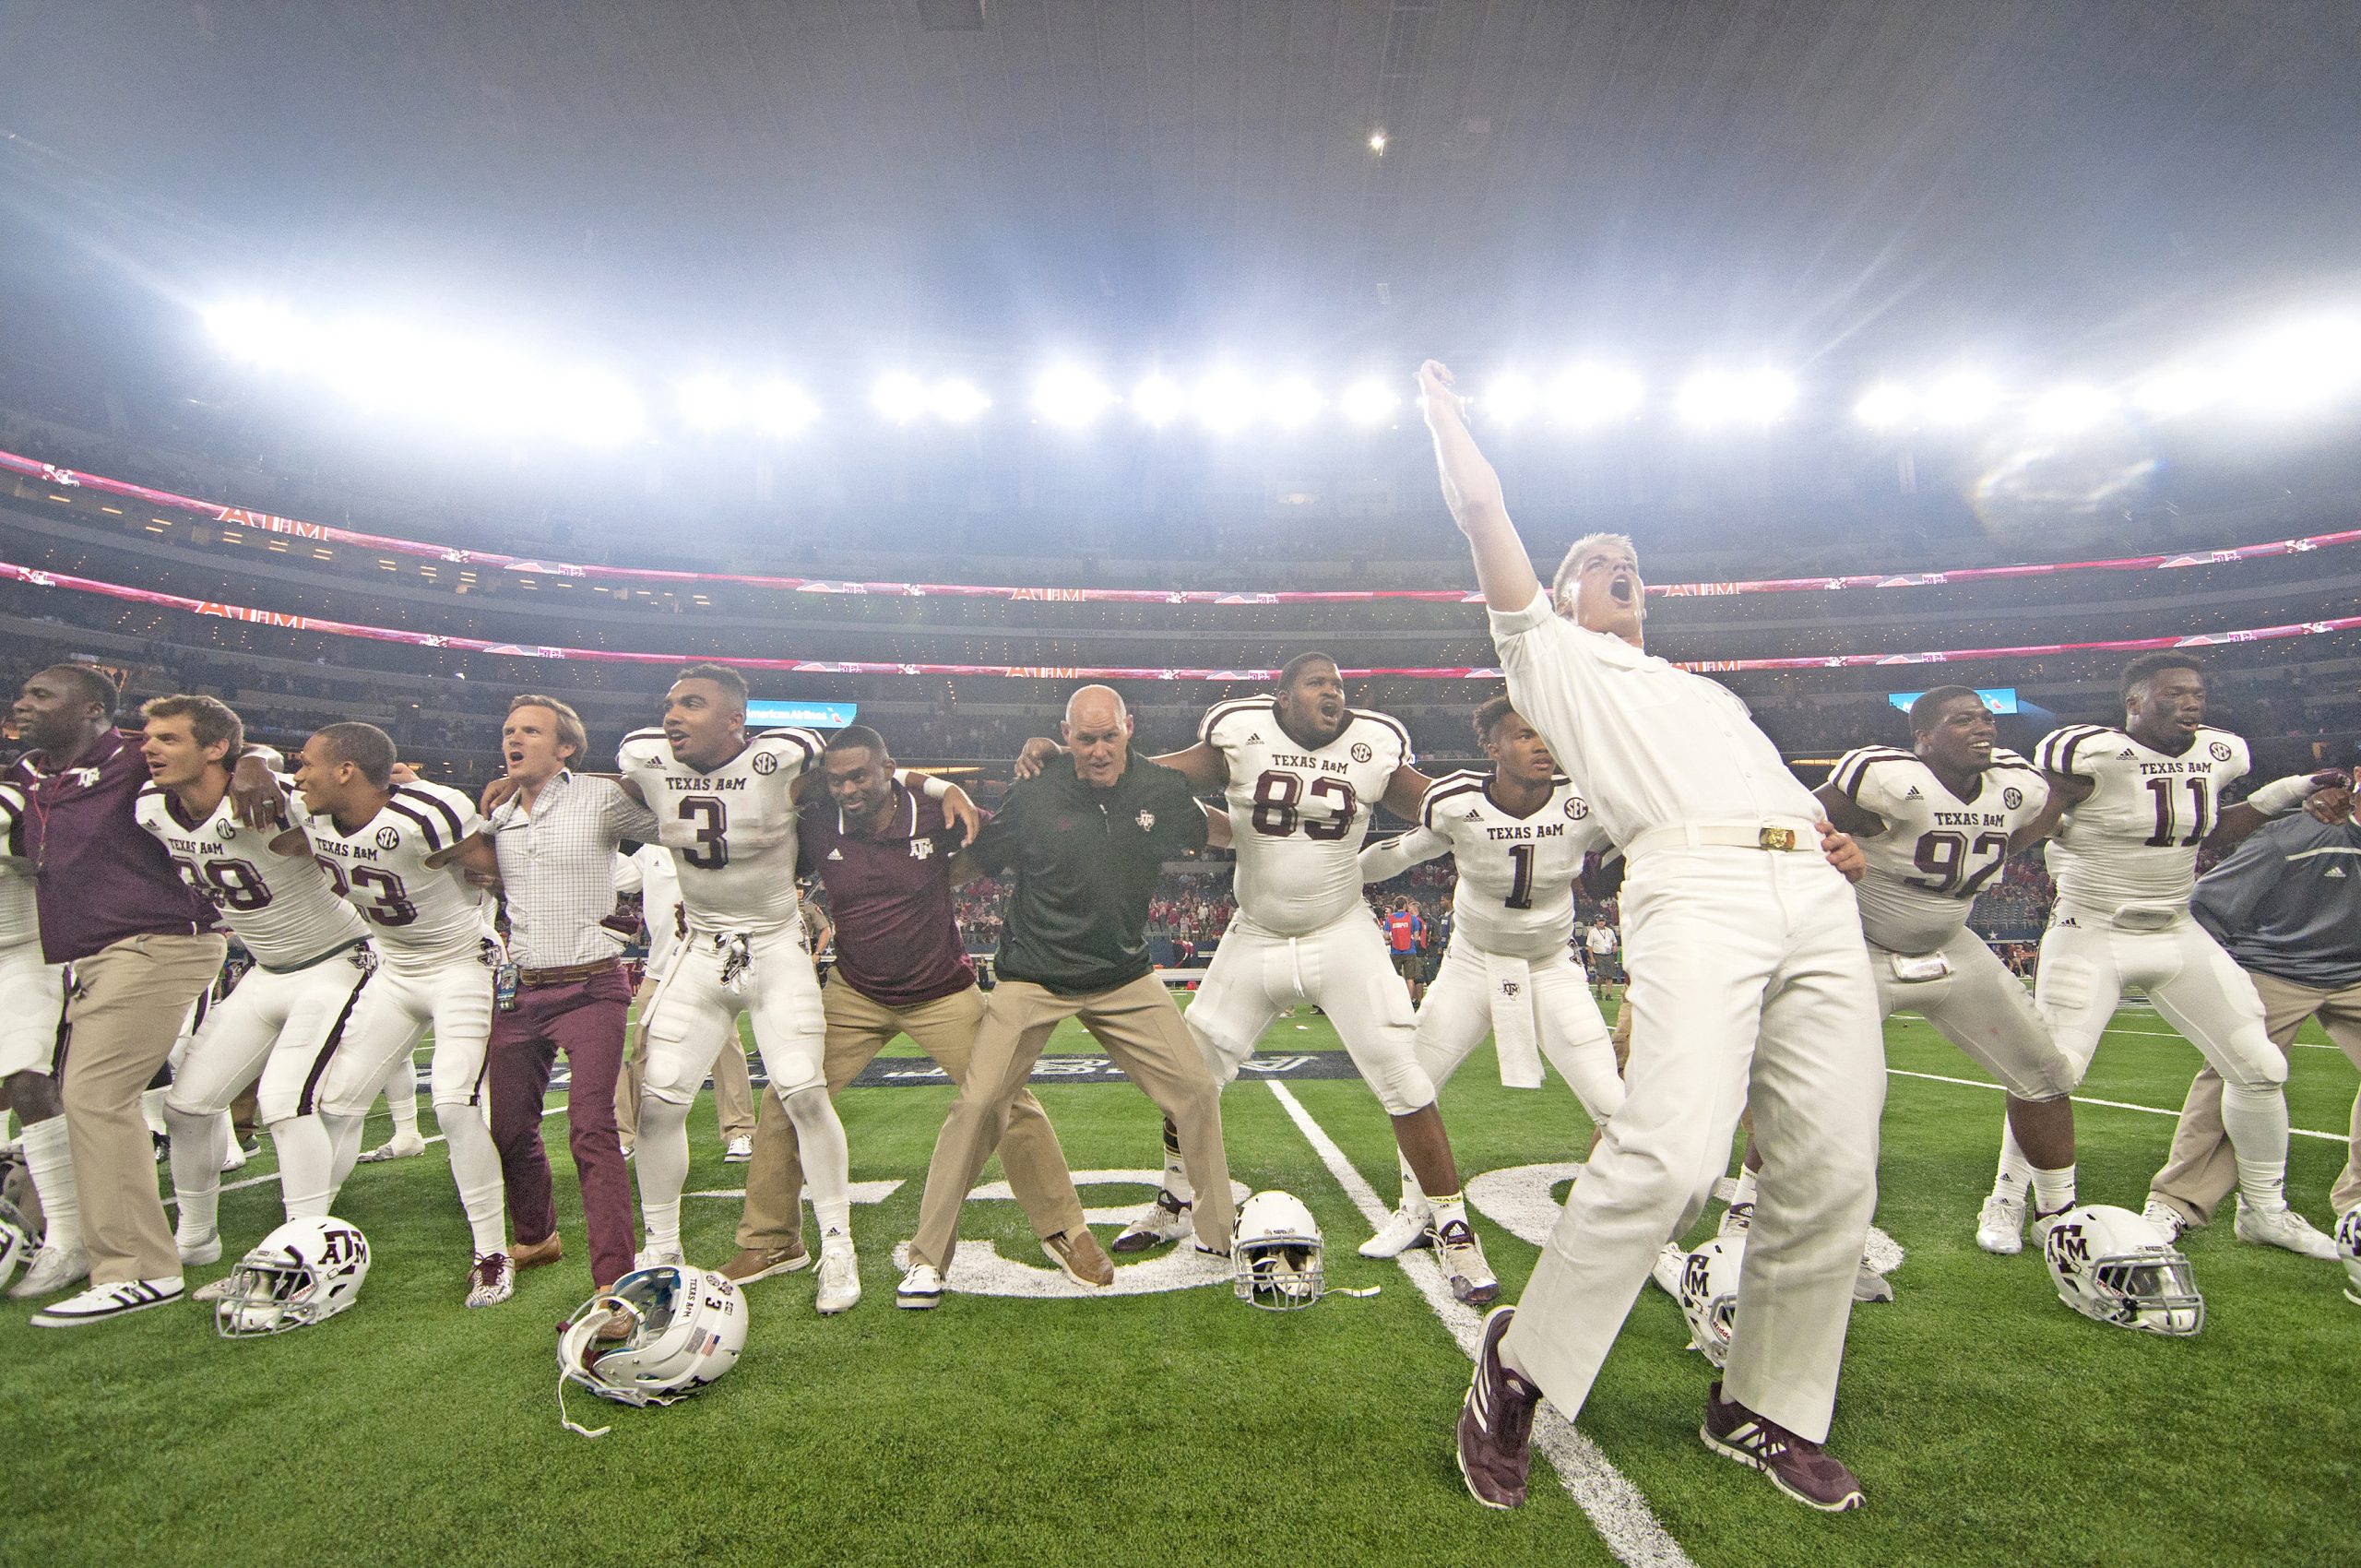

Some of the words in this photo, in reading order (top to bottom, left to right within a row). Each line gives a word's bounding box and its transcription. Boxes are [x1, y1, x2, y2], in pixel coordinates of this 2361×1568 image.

[753, 753, 777, 774] SEC
[1352, 743, 1372, 763] SEC
[1272, 754, 1317, 769] TEXAS
[1321, 760, 1349, 775] A&M
[2140, 763, 2185, 776] TEXAS
[2189, 763, 2213, 774] A&M
[665, 778, 710, 791] TEXAS
[715, 778, 747, 790] A&M
[1252, 769, 1357, 840] 83
[1565, 798, 1587, 820] SEC
[2004, 789, 2022, 809] SEC
[1934, 813, 1979, 826] TEXAS
[1983, 814, 2005, 827] A&M
[2143, 777, 2209, 848] 11
[377, 828, 399, 848] SEC
[678, 795, 729, 869] 3
[1487, 826, 1531, 840] TEXAS
[1536, 823, 1564, 838] A&M
[167, 837, 196, 854] TEXAS
[200, 841, 224, 855] A&M
[315, 837, 350, 857] TEXAS
[353, 846, 378, 861] A&M
[1904, 830, 2010, 898] 92
[1504, 844, 1536, 909] 1
[687, 1278, 697, 1301] TEXAS
[705, 1297, 722, 1310] 3
